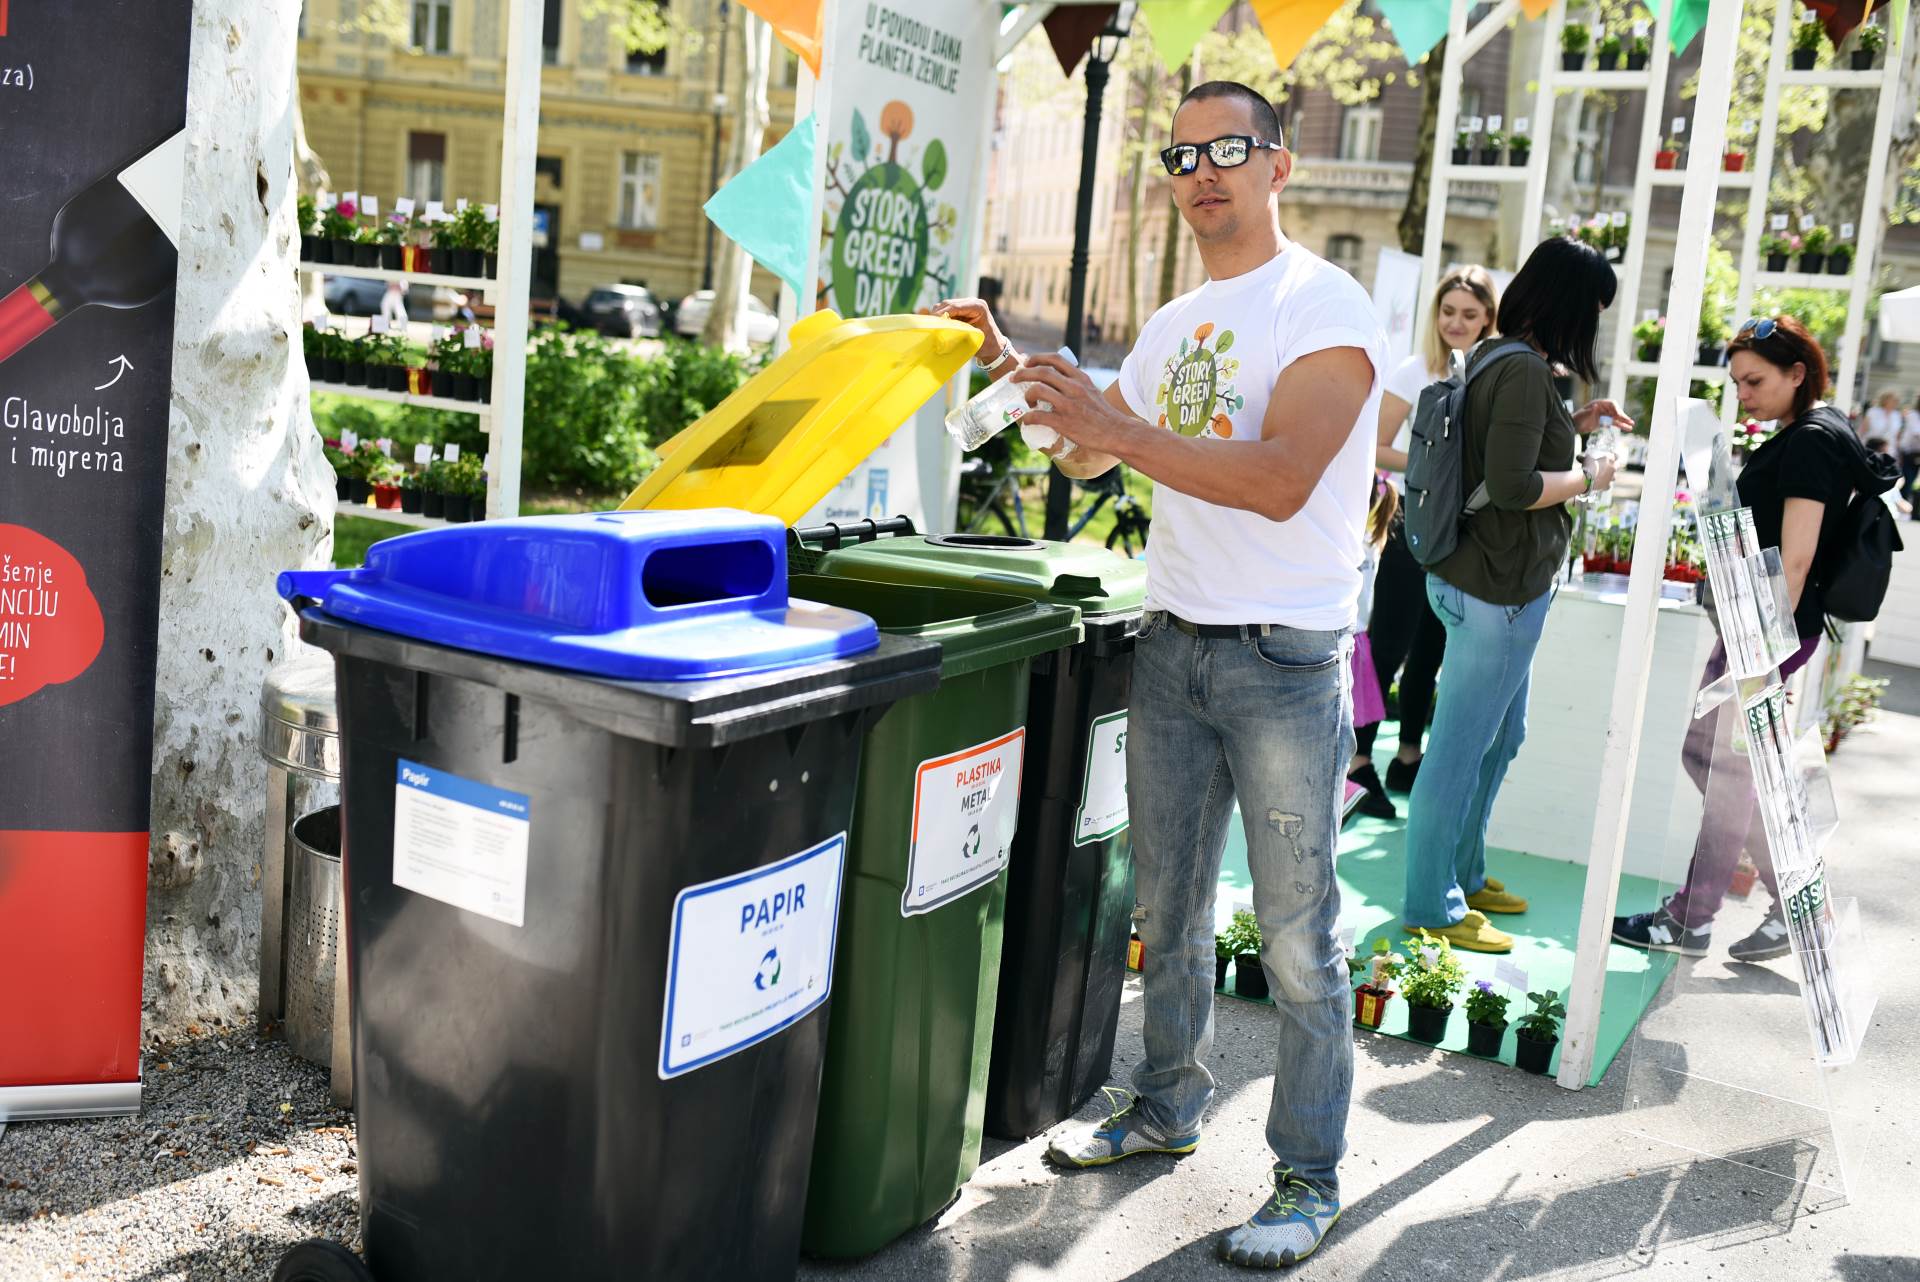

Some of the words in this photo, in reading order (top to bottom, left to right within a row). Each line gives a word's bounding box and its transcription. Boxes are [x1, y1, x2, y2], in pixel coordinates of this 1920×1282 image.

[865, 1, 877, 28] U
[878, 7, 931, 50] POVODU
[931, 29, 961, 63] DANA
[858, 34, 913, 77] PLANETA
[915, 55, 959, 95] ZEMLJE
[850, 187, 920, 239] STORY
[843, 229, 917, 278] GREEN
[854, 273, 899, 317] DAY
[1172, 381, 1210, 405] GREEN
[1176, 360, 1211, 385] STORY
[4, 396, 125, 446] Glavobolja
[1180, 402, 1203, 426] DAY
[11, 436, 17, 464] i
[30, 439, 123, 478] migrena
[0, 588, 59, 617] NCIJU
[402, 767, 430, 787] Papir
[956, 757, 1002, 788] PLASTIKA
[740, 883, 806, 933] PAPIR
